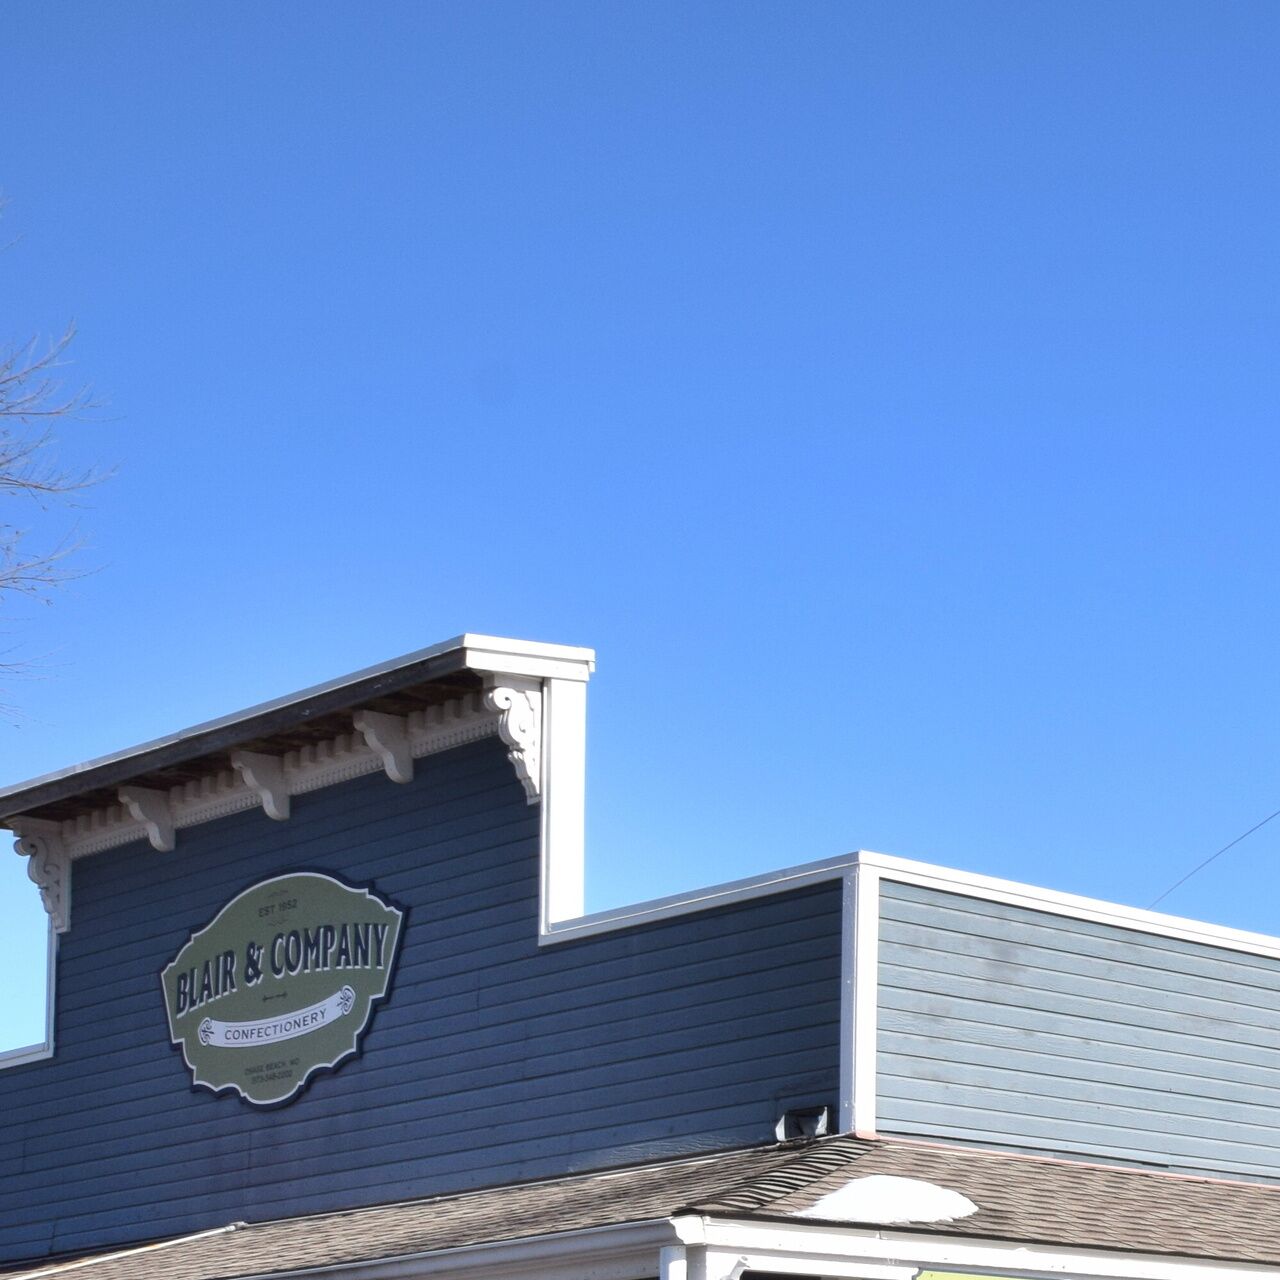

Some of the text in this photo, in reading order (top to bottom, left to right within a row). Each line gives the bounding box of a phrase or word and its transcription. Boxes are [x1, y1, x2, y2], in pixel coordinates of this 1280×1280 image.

[176, 922, 390, 1019] BLAIR & COMPANY
[224, 1008, 328, 1041] CONFECTIONERY
